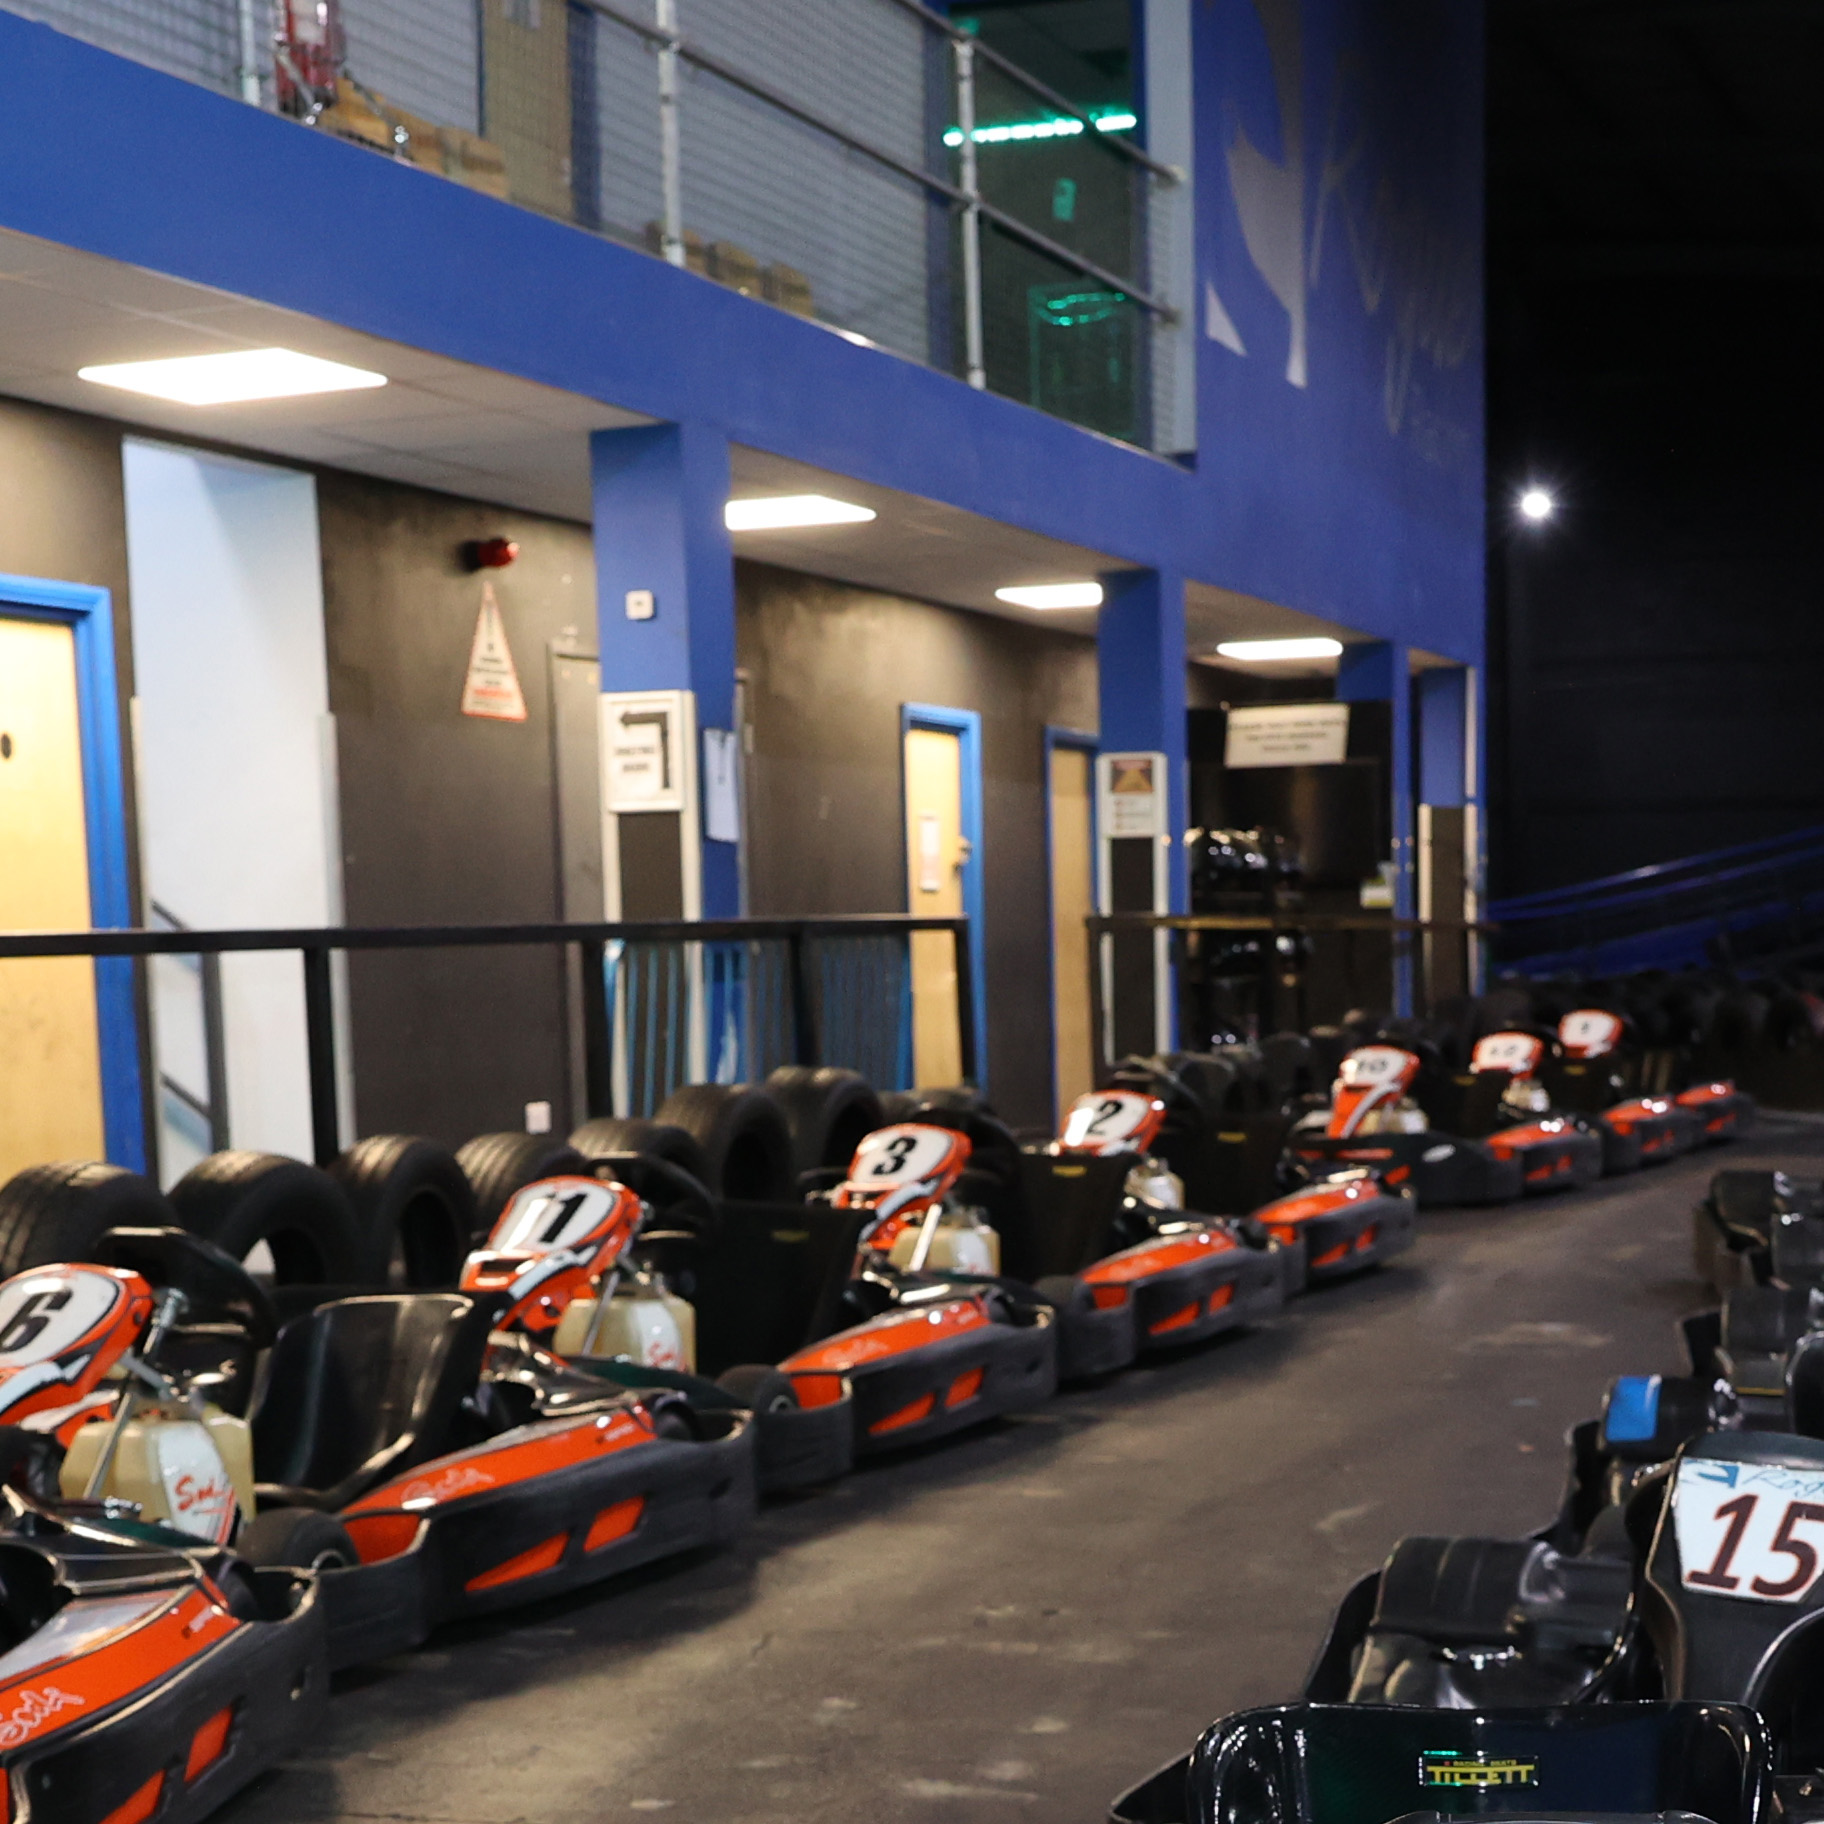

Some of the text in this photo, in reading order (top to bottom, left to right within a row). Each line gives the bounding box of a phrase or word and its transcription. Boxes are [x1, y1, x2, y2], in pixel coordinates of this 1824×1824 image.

[1086, 1099, 1123, 1136] 2
[872, 1135, 918, 1176] 3
[508, 1192, 588, 1244] 1
